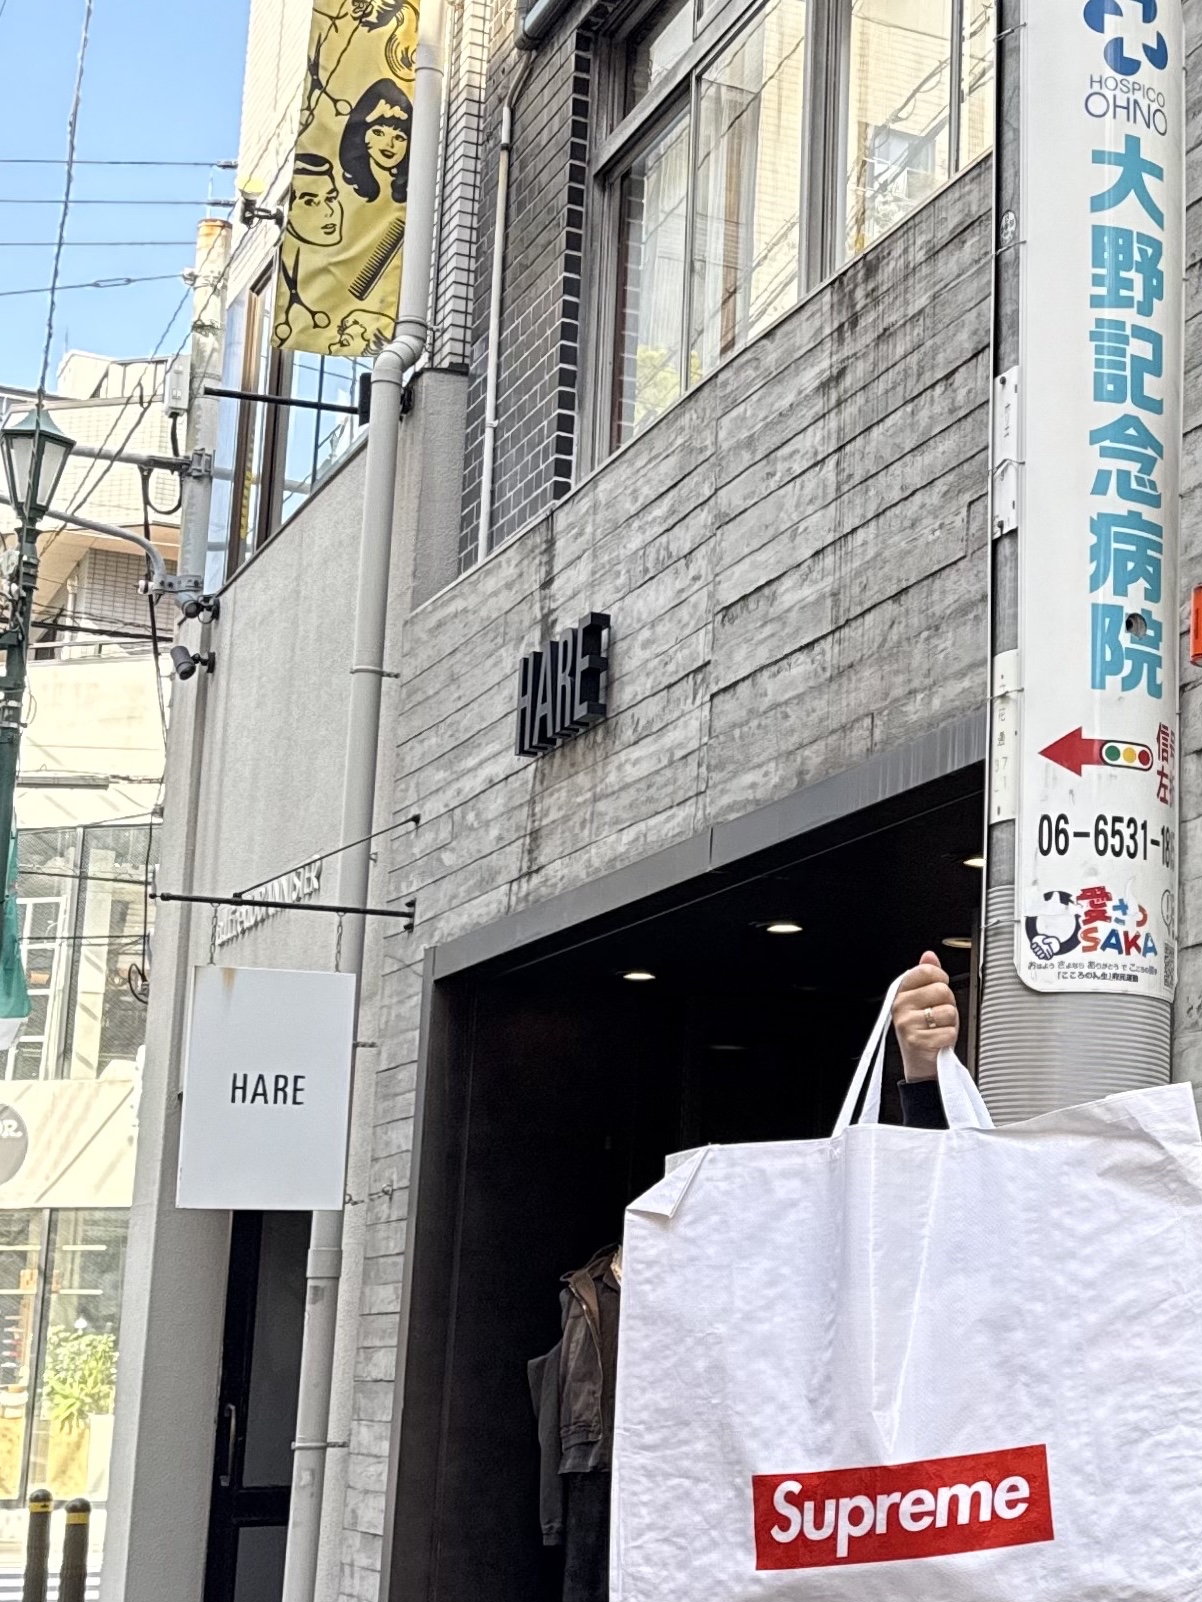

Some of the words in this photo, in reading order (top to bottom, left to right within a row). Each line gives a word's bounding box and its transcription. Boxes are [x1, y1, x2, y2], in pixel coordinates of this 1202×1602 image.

[1084, 91, 1168, 137] OHNO
[1089, 73, 1166, 109] HOSPICO
[1089, 133, 1165, 700] 大野記念病院
[514, 611, 612, 758] HARE
[230, 1073, 306, 1106] HARE
[769, 1474, 1031, 1559] Supreme
